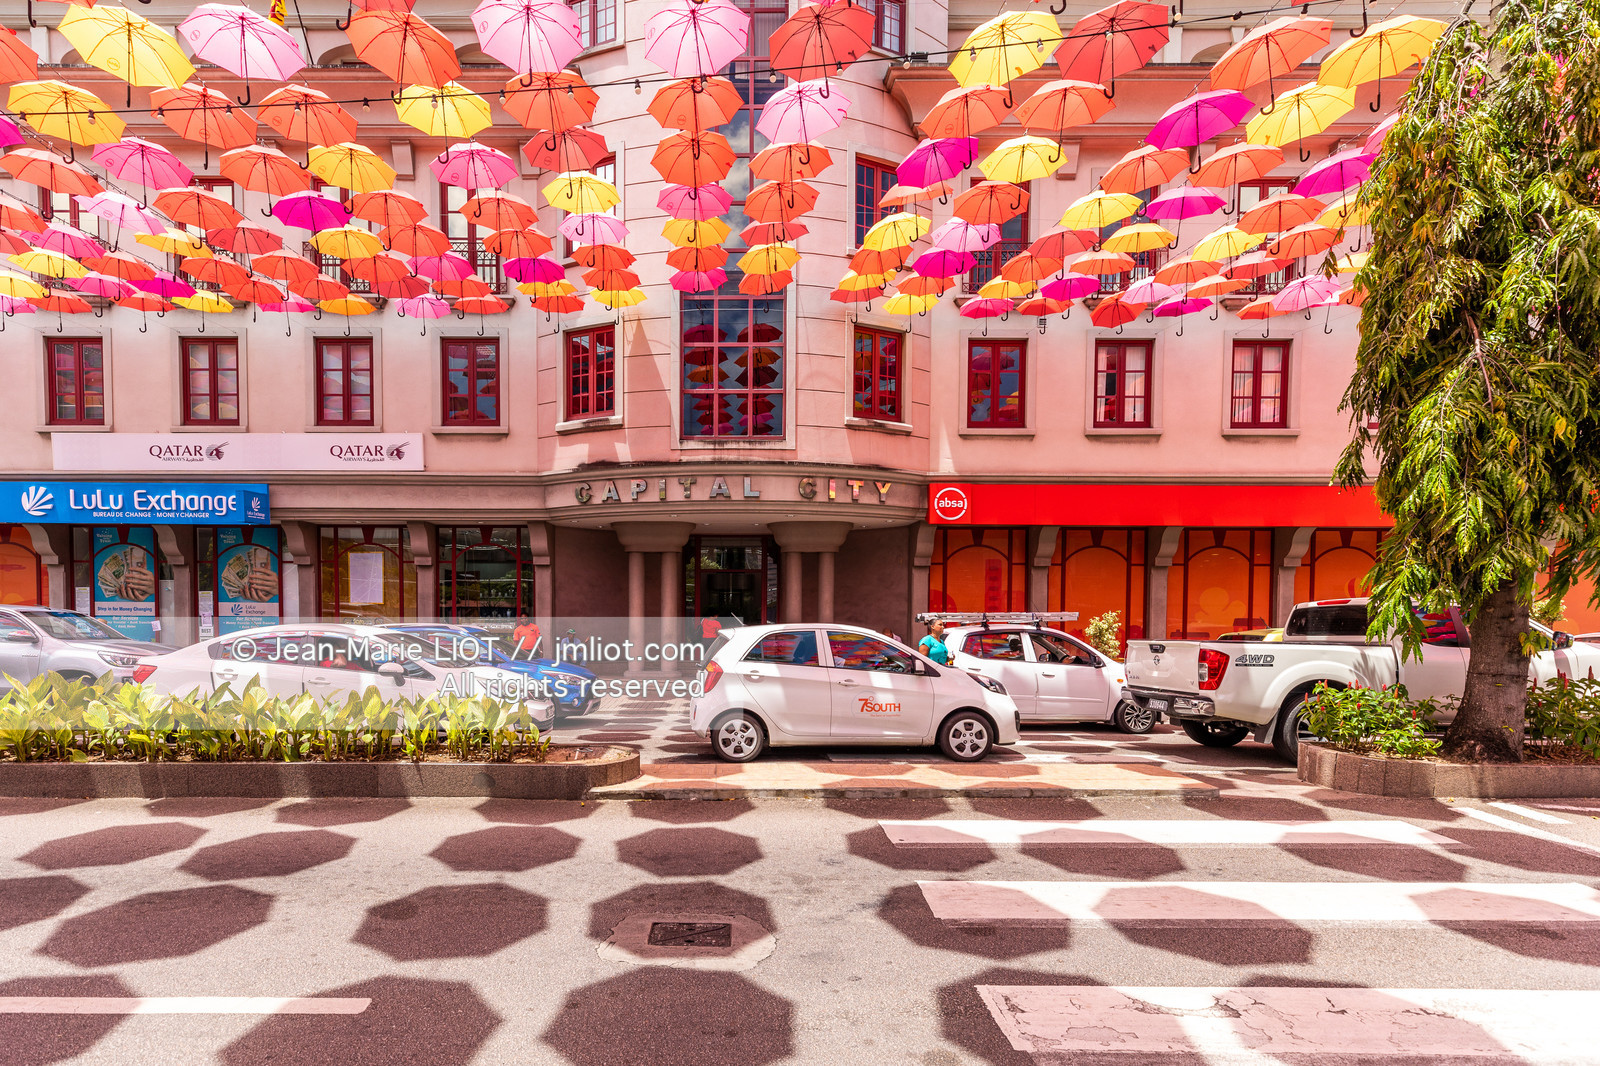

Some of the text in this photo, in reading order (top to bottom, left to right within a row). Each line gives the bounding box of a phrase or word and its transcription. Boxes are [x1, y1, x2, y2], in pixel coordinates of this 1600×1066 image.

[149, 445, 203, 459] QATAR
[329, 445, 384, 459] QATAR
[574, 476, 892, 503] CAPITAL CITY
[69, 488, 237, 516] LuLu Exchange
[938, 497, 964, 508] absa
[1235, 654, 1275, 663] 4WD
